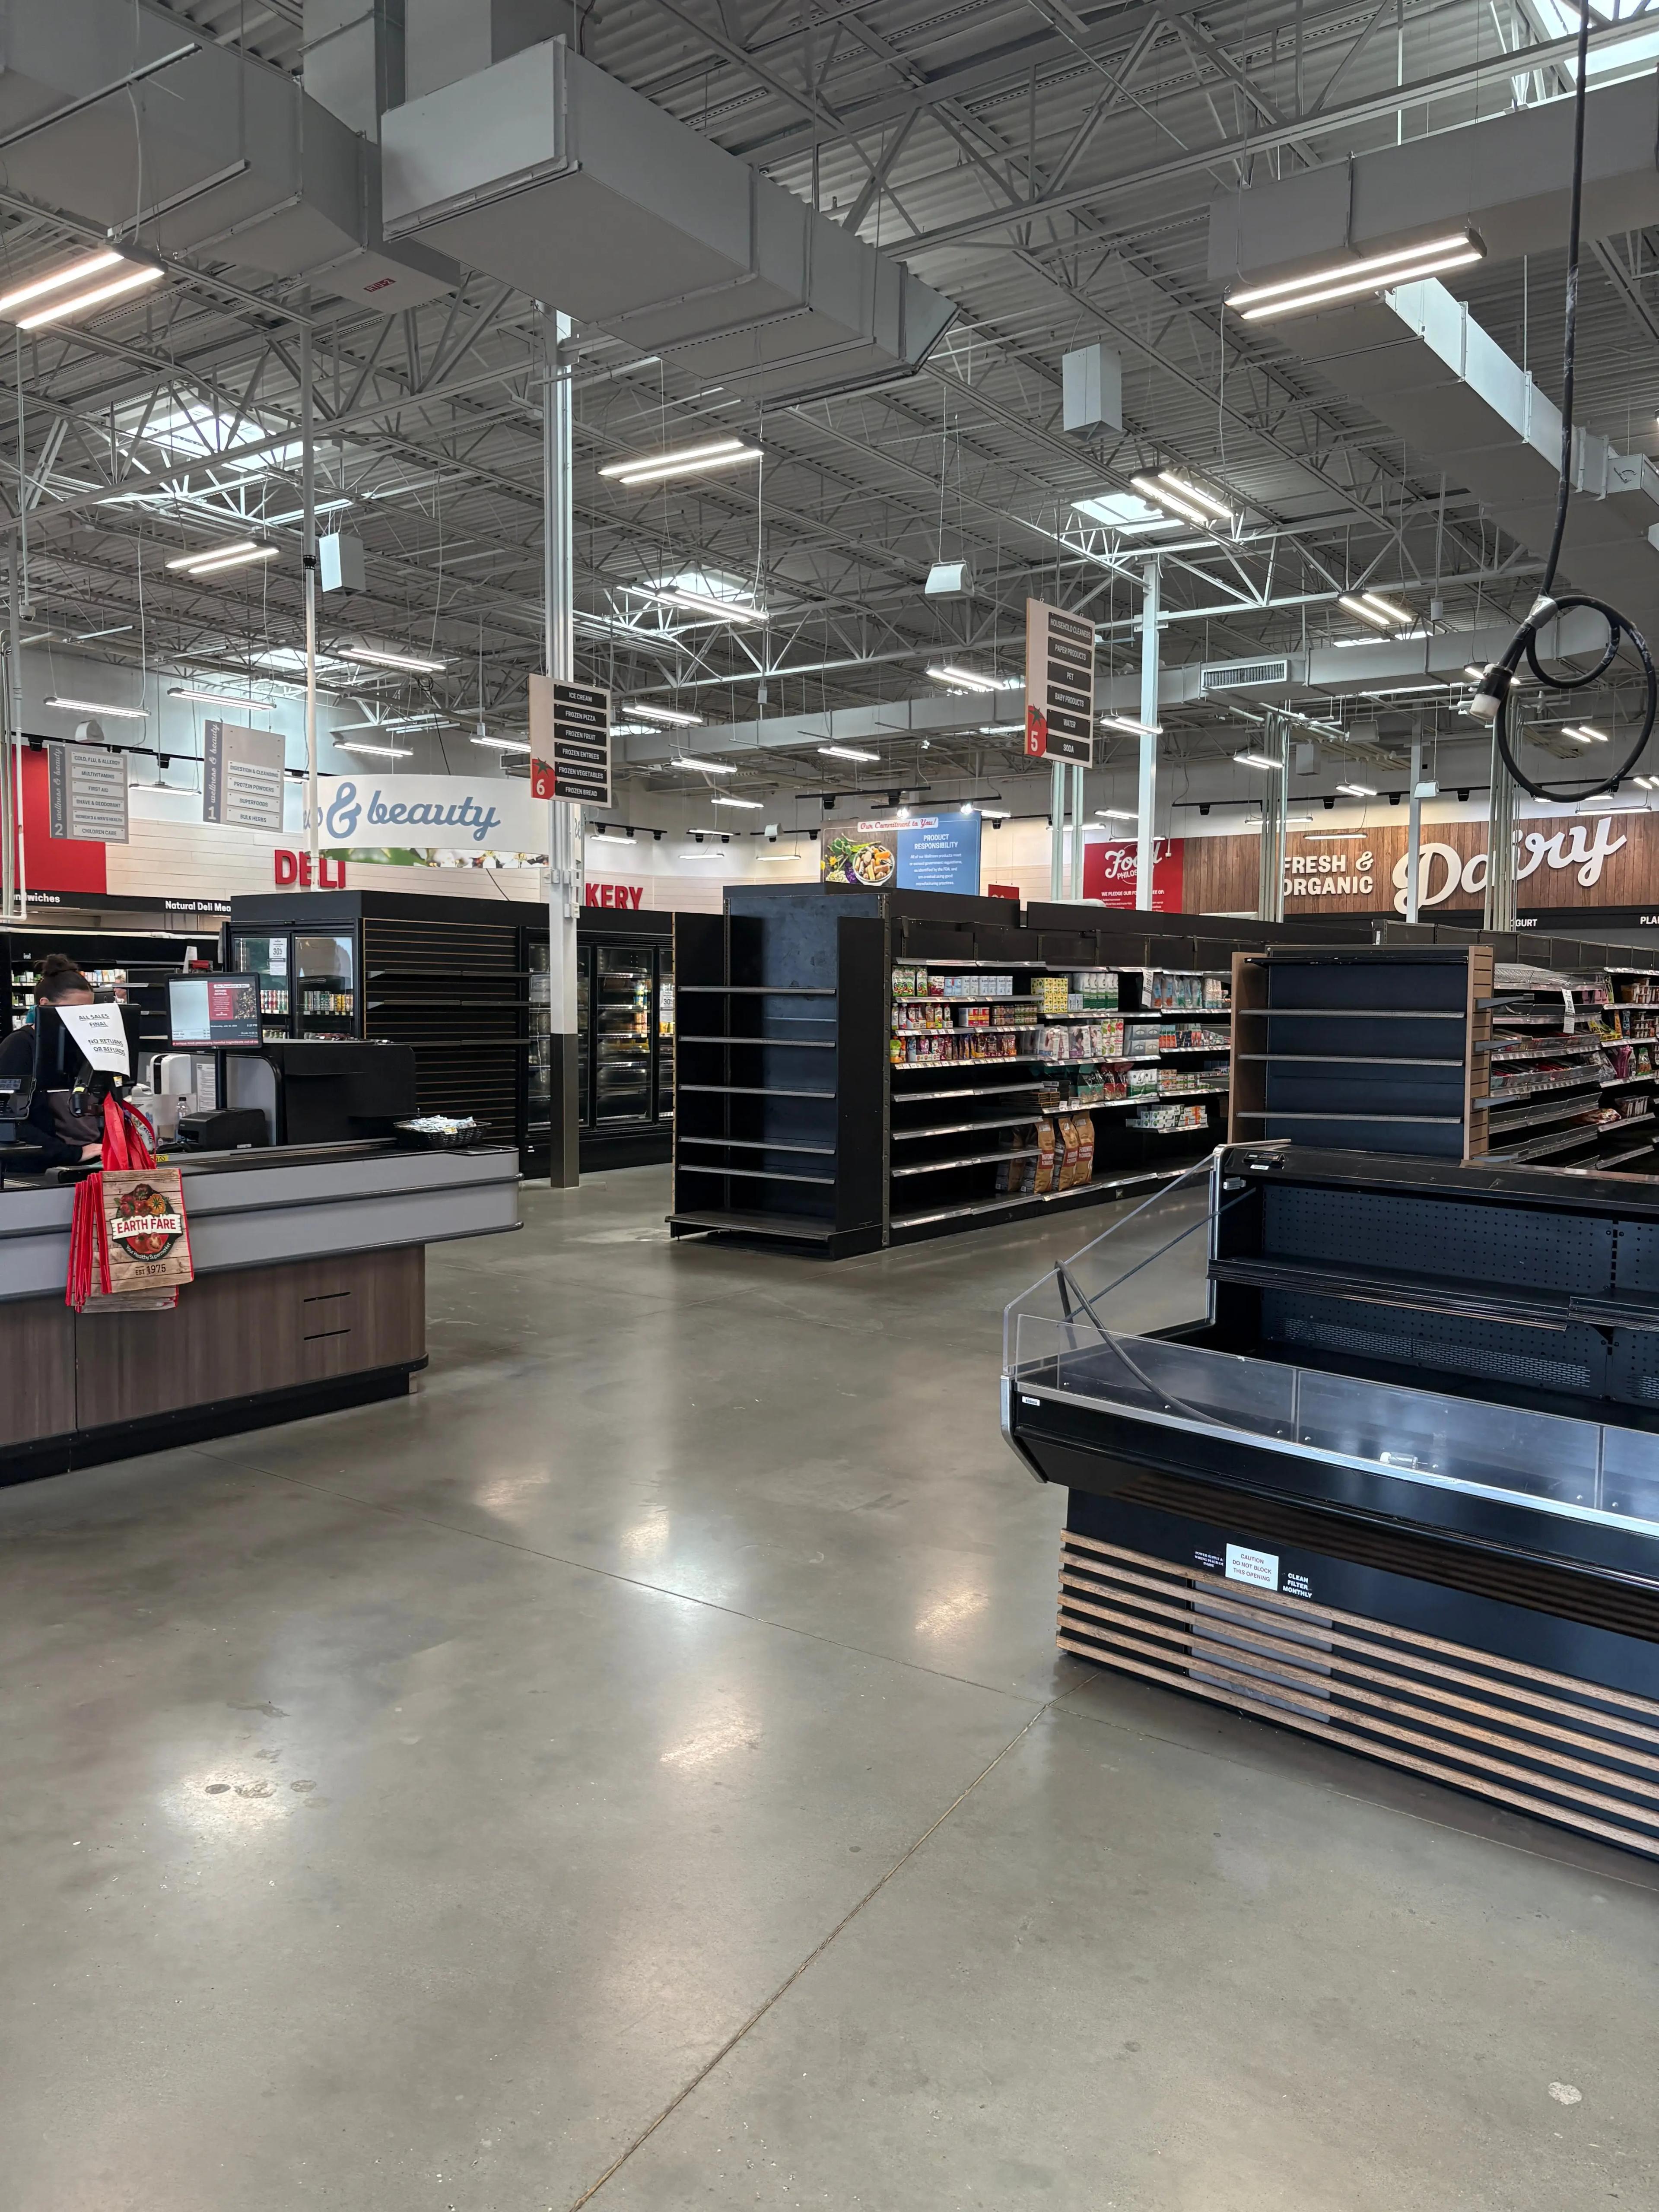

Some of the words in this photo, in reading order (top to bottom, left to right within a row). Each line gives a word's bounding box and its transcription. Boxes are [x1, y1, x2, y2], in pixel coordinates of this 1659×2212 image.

[366, 280, 392, 291] RTU-2
[1050, 618, 1072, 632] HOUSEHOLD
[1073, 625, 1090, 639] CLEANERS
[1055, 644, 1067, 654] PAPER
[1068, 648, 1086, 661] PRODUCTS
[577, 694, 592, 702] CREAM
[1055, 692, 1065, 702] BABY
[1065, 696, 1084, 707] PRODUCTS
[566, 711, 582, 719] FROZEN
[583, 714, 596, 722] PIZZA
[1063, 718, 1076, 728] WATER
[210, 724, 220, 754] beauty
[566, 730, 583, 738] FROZEN
[1031, 731, 1038, 751] 5
[563, 748, 579, 757] FROZEN
[580, 751, 599, 760] ENTREES
[1063, 744, 1074, 753] SODA
[54, 748, 63, 776] beauty
[209, 756, 216, 765] &
[256, 769, 278, 778] CLEANSING
[559, 767, 576, 775] FROZEN
[577, 769, 603, 779] VEGETABLES
[537, 779, 545, 795] 6
[566, 787, 582, 795] FROZEN
[239, 798, 268, 807] SUPERFOODS
[208, 806, 216, 820] 1
[327, 782, 361, 839] &
[367, 790, 501, 841] beauty
[55, 823, 63, 836] 2
[920, 819, 936, 828] You!
[1356, 851, 1374, 871] &
[1392, 817, 1627, 914] Dairy
[274, 849, 346, 888] DELI
[1283, 876, 1373, 896] ORGANIC
[586, 883, 643, 910] KERY
[165, 901, 196, 911] Natural
[198, 902, 213, 911] Deli
[215, 903, 231, 912] Mea
[117, 1219, 148, 1233] EARTH
[151, 1219, 176, 1229] FARE
[133, 1252, 149, 1261] Healthy
[149, 1243, 171, 1259] Supermarket
[146, 1264, 165, 1274] 1975
[1240, 1554, 1264, 1564] CAUTION
[1253, 1565, 1271, 1574] BLOCK
[1246, 1571, 1270, 1582] OPENING
[1288, 1573, 1308, 1583] CLEAN
[1287, 1580, 1308, 1590] FILTER
[1283, 1586, 1312, 1599] MONTHLY
